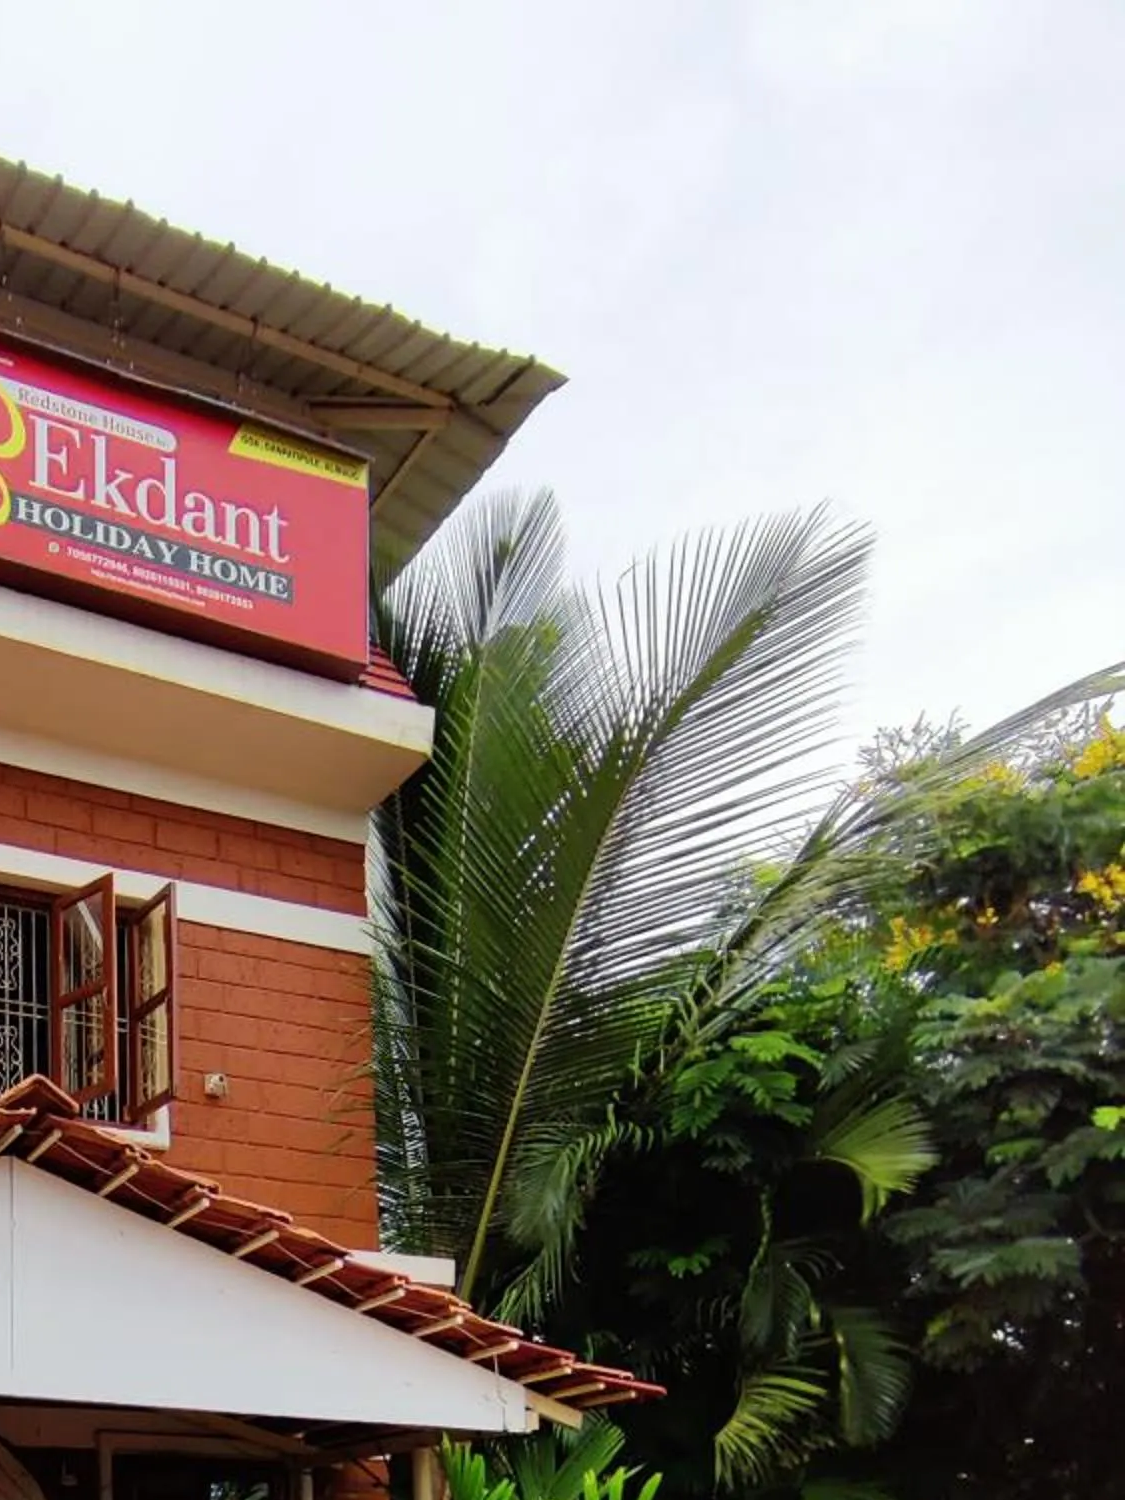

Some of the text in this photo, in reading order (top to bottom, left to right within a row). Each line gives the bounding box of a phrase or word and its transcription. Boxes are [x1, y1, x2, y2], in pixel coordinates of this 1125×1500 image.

[17, 386, 154, 442] Redstone House
[29, 414, 291, 564] Ekdant
[15, 497, 179, 565] HOLIDAY
[189, 551, 291, 598] HOME
